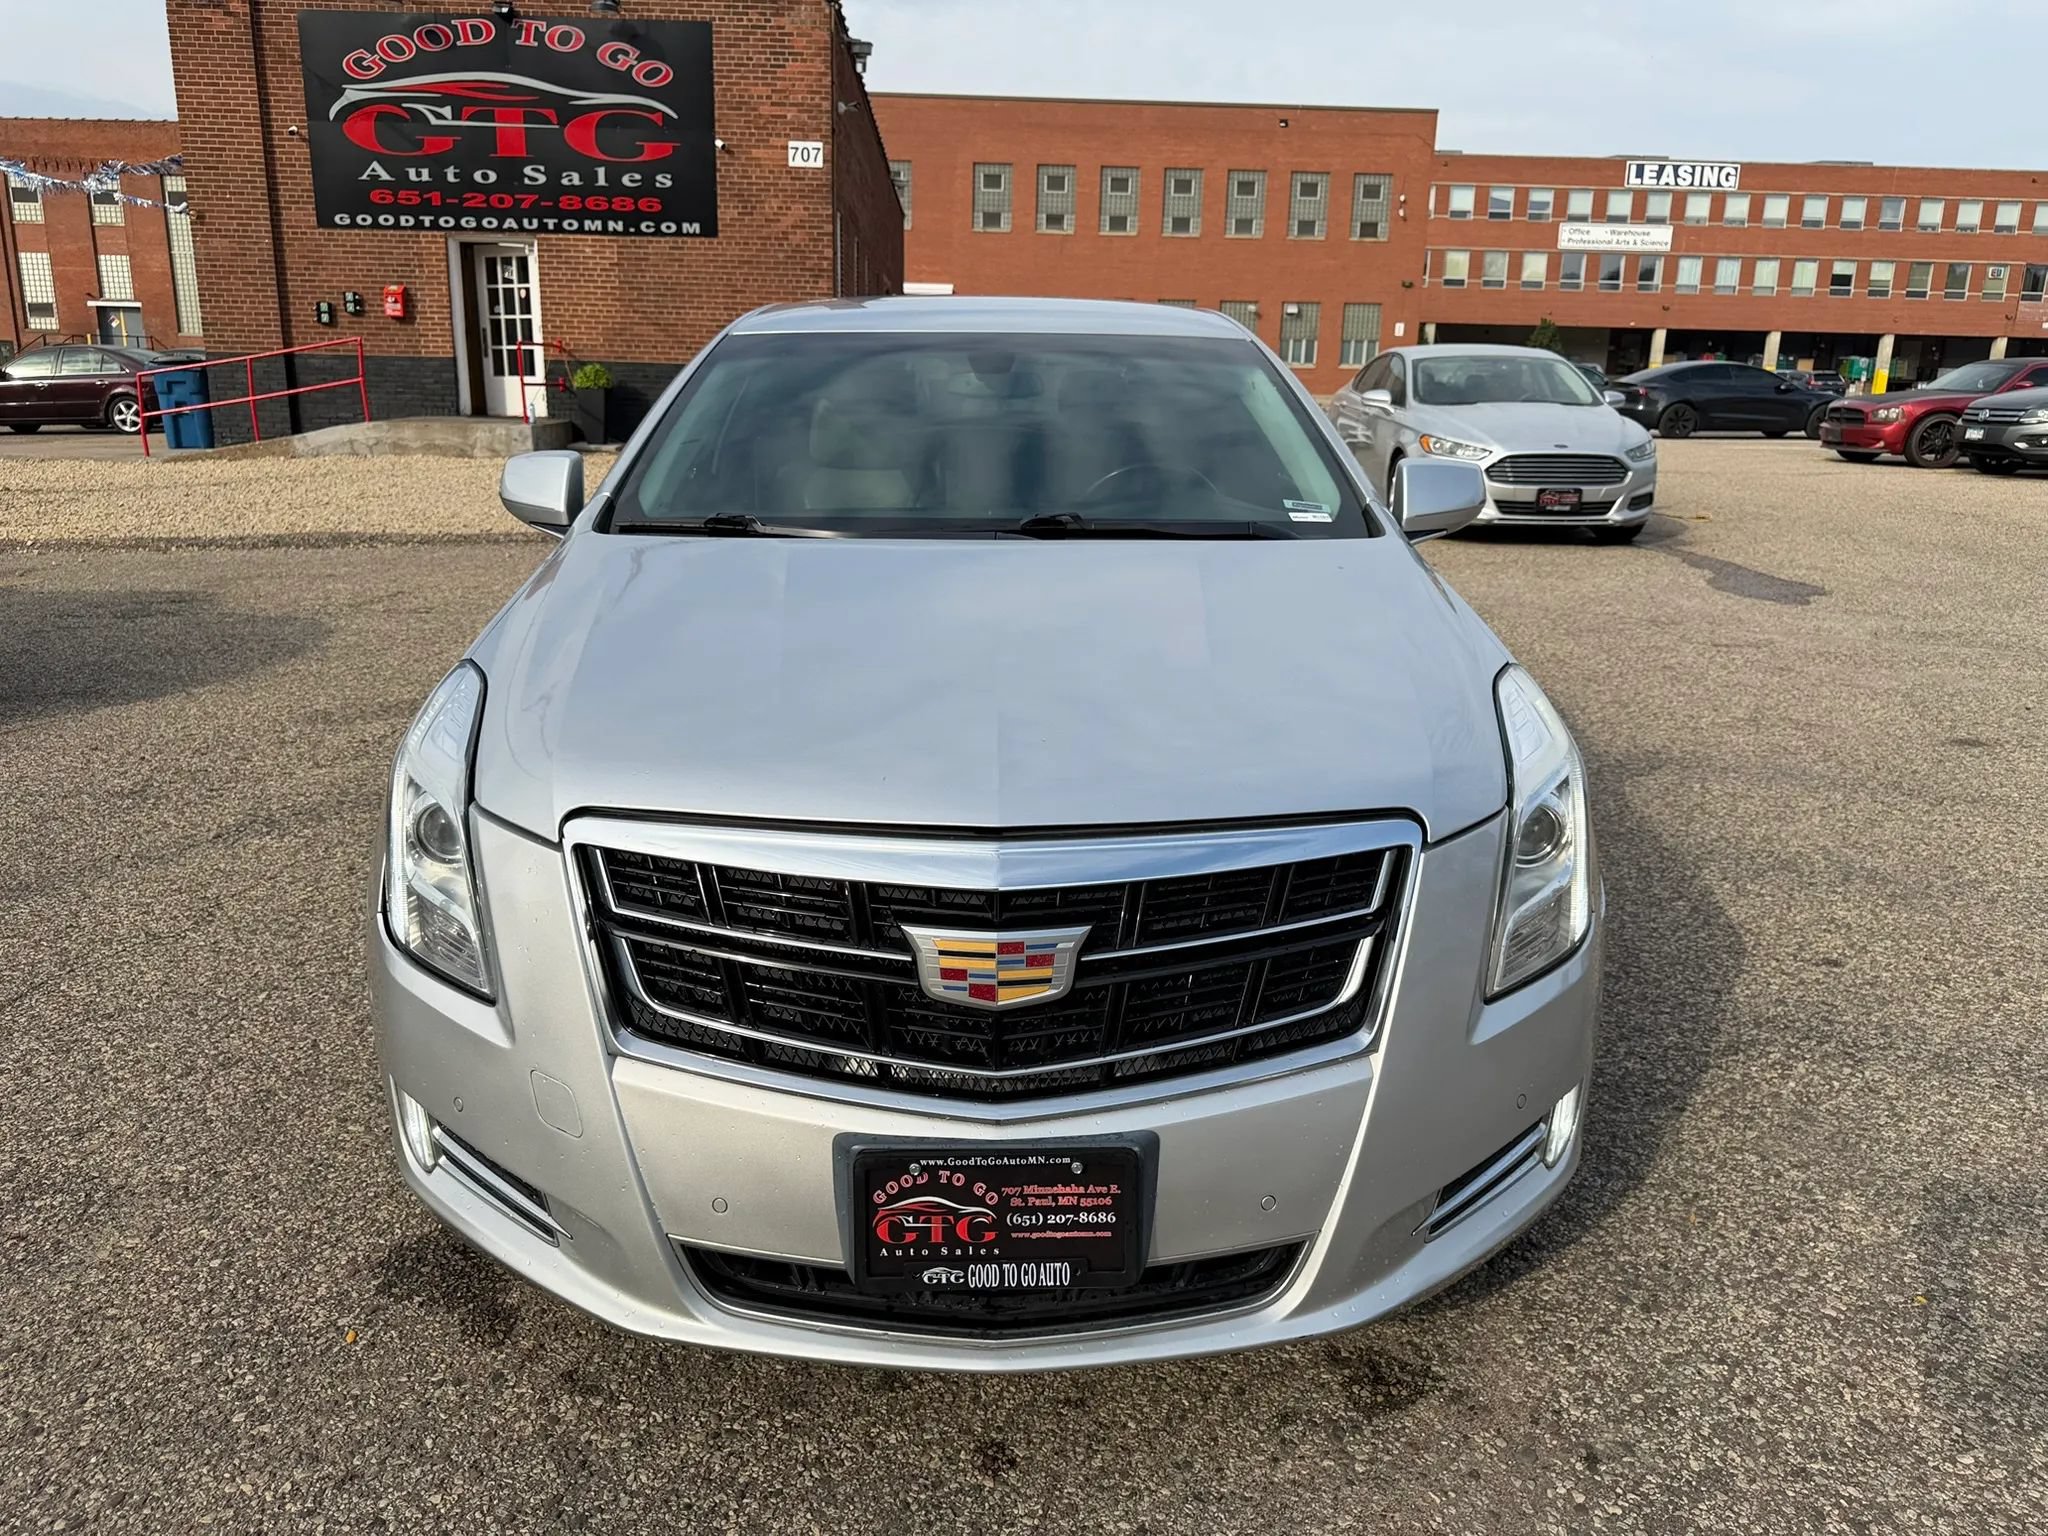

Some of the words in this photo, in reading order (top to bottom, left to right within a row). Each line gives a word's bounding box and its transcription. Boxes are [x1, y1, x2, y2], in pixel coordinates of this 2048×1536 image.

[342, 18, 496, 80] GOOD
[511, 18, 586, 53] TO
[596, 41, 674, 88] GO
[341, 104, 681, 163] GTG
[790, 146, 821, 163] 707
[357, 160, 498, 184] Auto
[522, 164, 673, 189] Sales
[1627, 163, 1737, 188] LEASING
[369, 188, 663, 213] 651-207-8686
[333, 213, 701, 235] GOODTOGOAUTOMN.COM
[1568, 227, 1591, 236] Office
[1609, 229, 1651, 237] Warehouse
[1566, 237, 1613, 246] Professional
[1615, 238, 1630, 246] Arts
[919, 1156, 1071, 1166] www.GoodToGoAutoMN.com
[872, 1171, 929, 1204] GOOD
[938, 1170, 966, 1187] TO
[973, 1182, 999, 1206] GO
[1001, 1187, 1022, 1197] 707
[1023, 1184, 1086, 1195] Minnehaha
[1087, 1184, 1108, 1194] Ave
[1110, 1184, 1122, 1194] E.
[1010, 1197, 1026, 1207] St.
[1027, 1196, 1056, 1207] Paul,
[1058, 1196, 1078, 1206] MN
[1079, 1195, 1113, 1207] 55106
[876, 1215, 999, 1244] GTG
[1006, 1212, 1043, 1226] (651)
[1047, 1211, 1117, 1226] 207-8686
[879, 1247, 929, 1257] Auto
[940, 1246, 1000, 1256] Sales
[967, 1263, 1000, 1288] GOOD
[1002, 1263, 1018, 1287] TO
[1020, 1262, 1037, 1287] GO
[1038, 1261, 1071, 1287] AUTO
